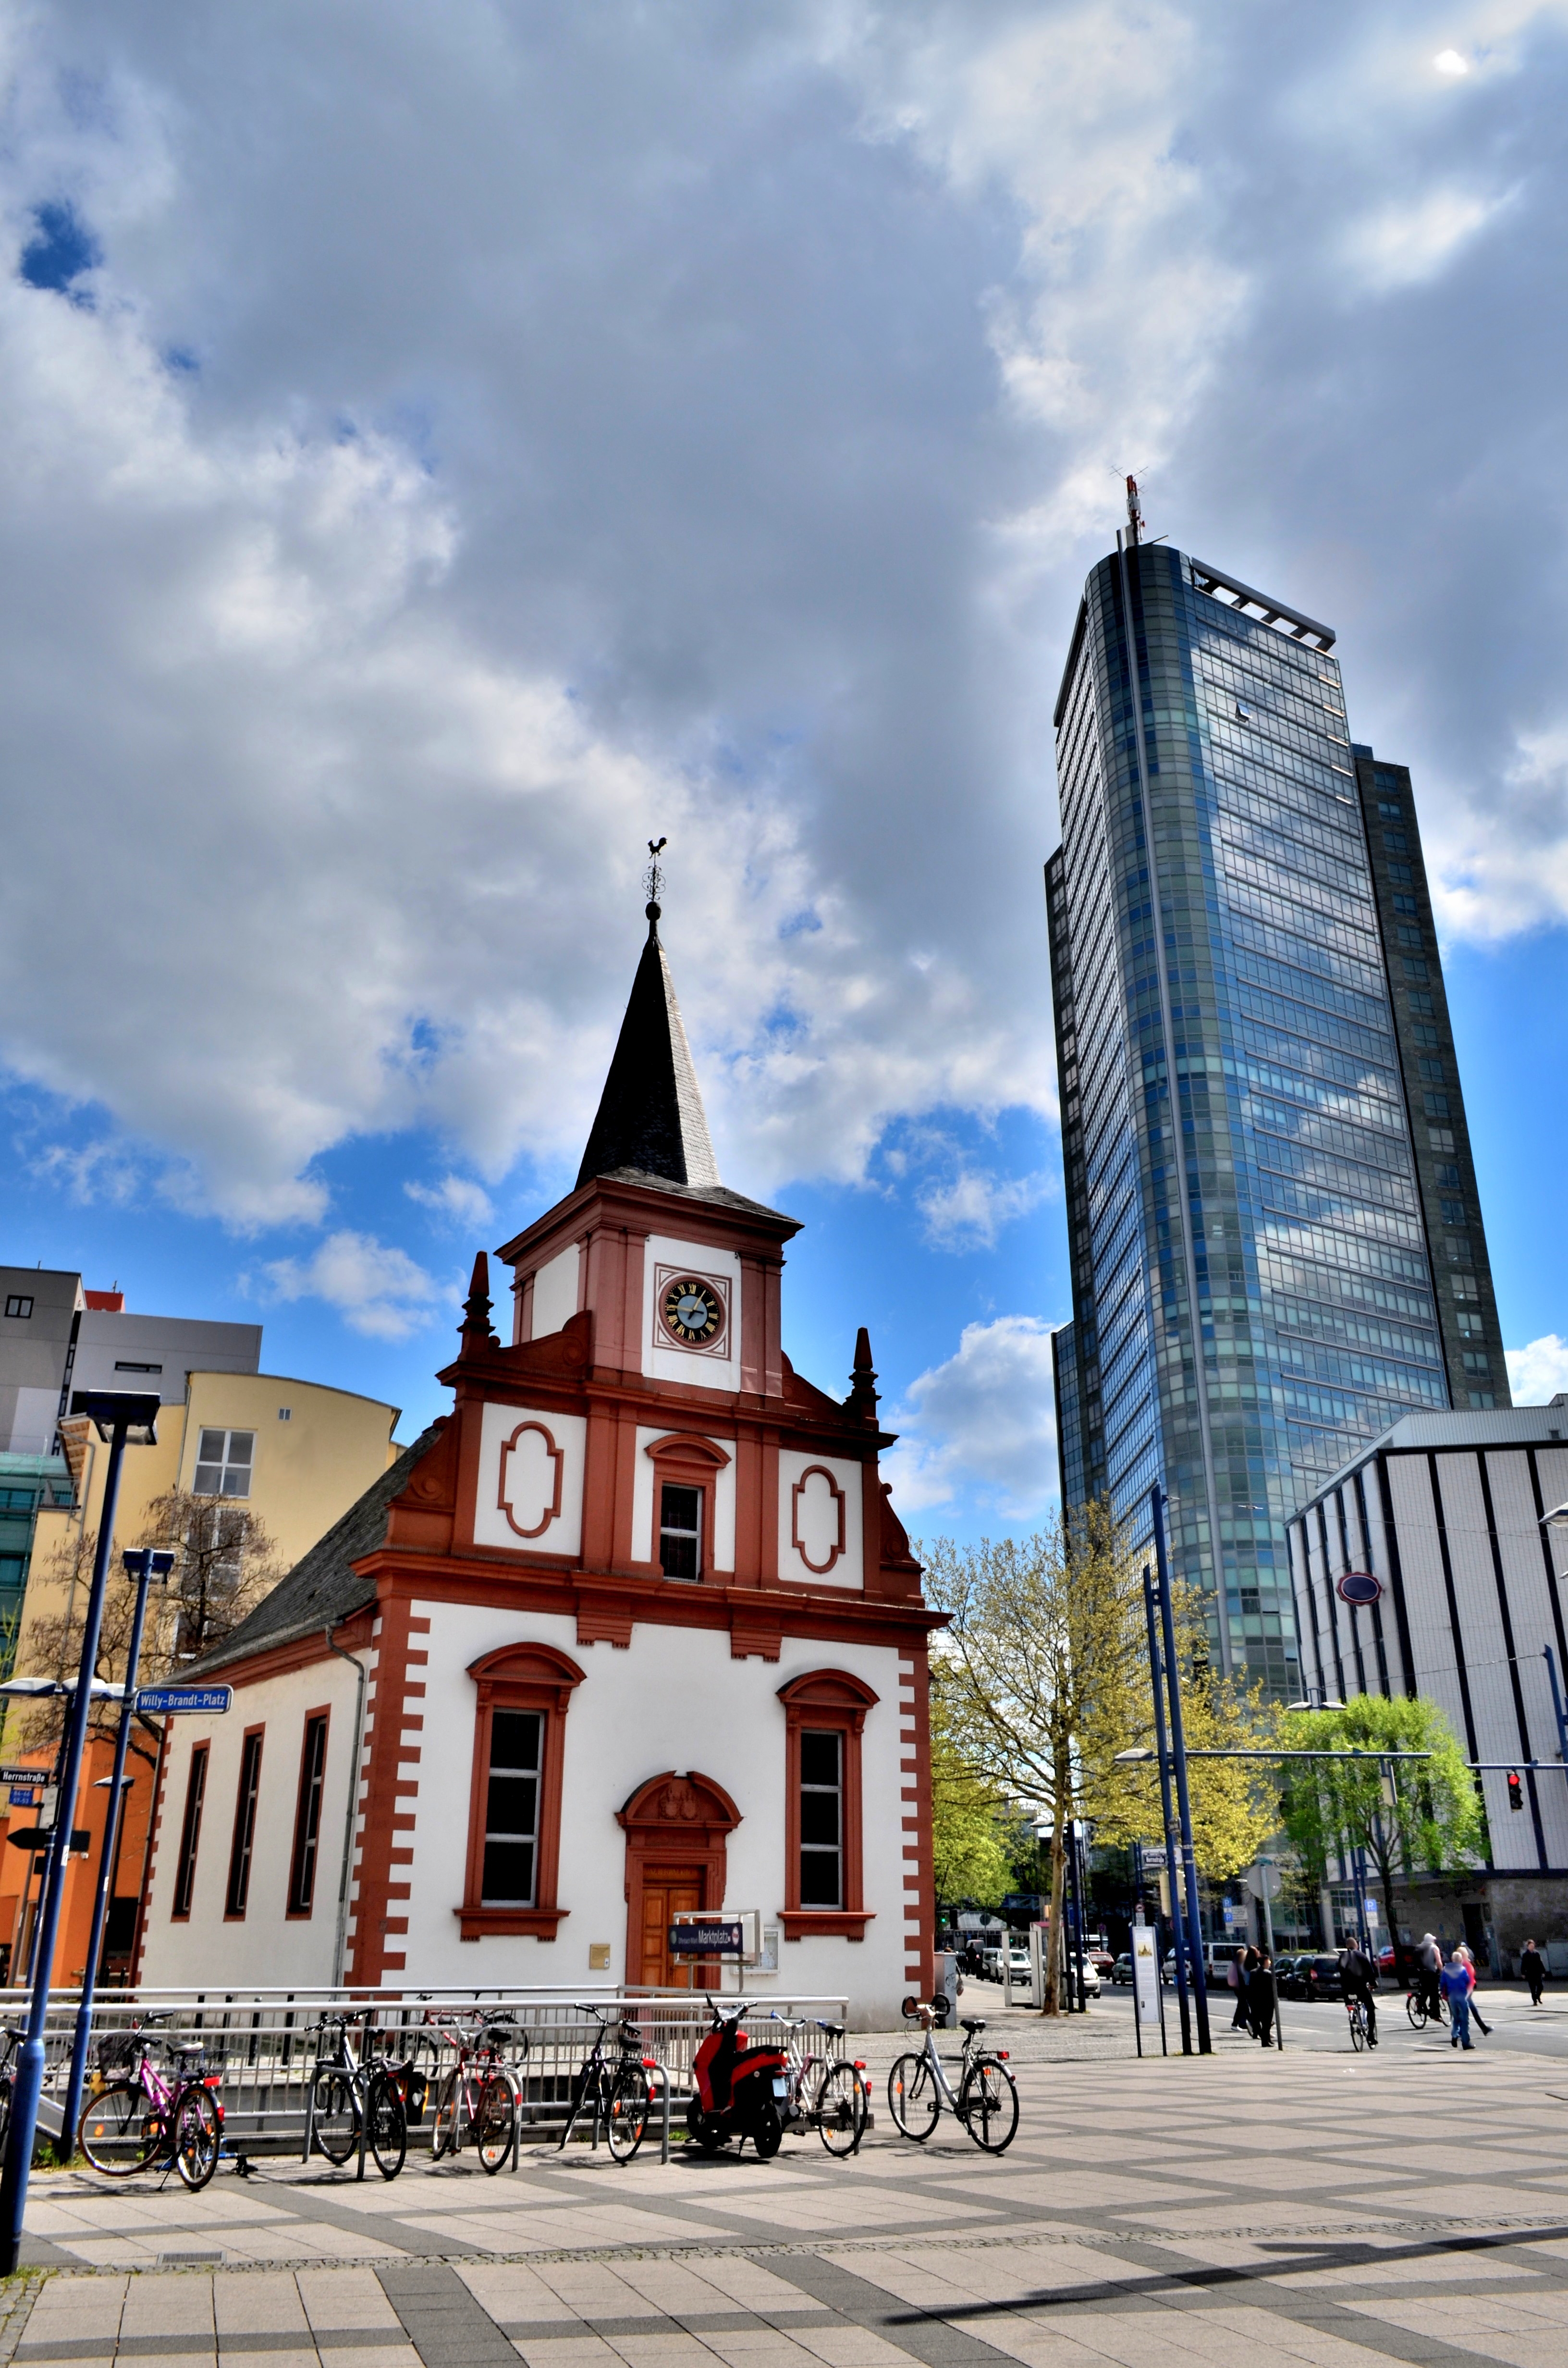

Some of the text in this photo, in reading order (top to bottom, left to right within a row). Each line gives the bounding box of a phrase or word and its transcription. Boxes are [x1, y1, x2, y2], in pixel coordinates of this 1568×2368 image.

[669, 1292, 679, 1302] X
[141, 1693, 225, 1709] Willy-Brandt-Platz
[2, 1771, 45, 1783] Herrnstraße
[1367, 1901, 1373, 1910] P
[698, 1930, 728, 1947] Marktplatz
